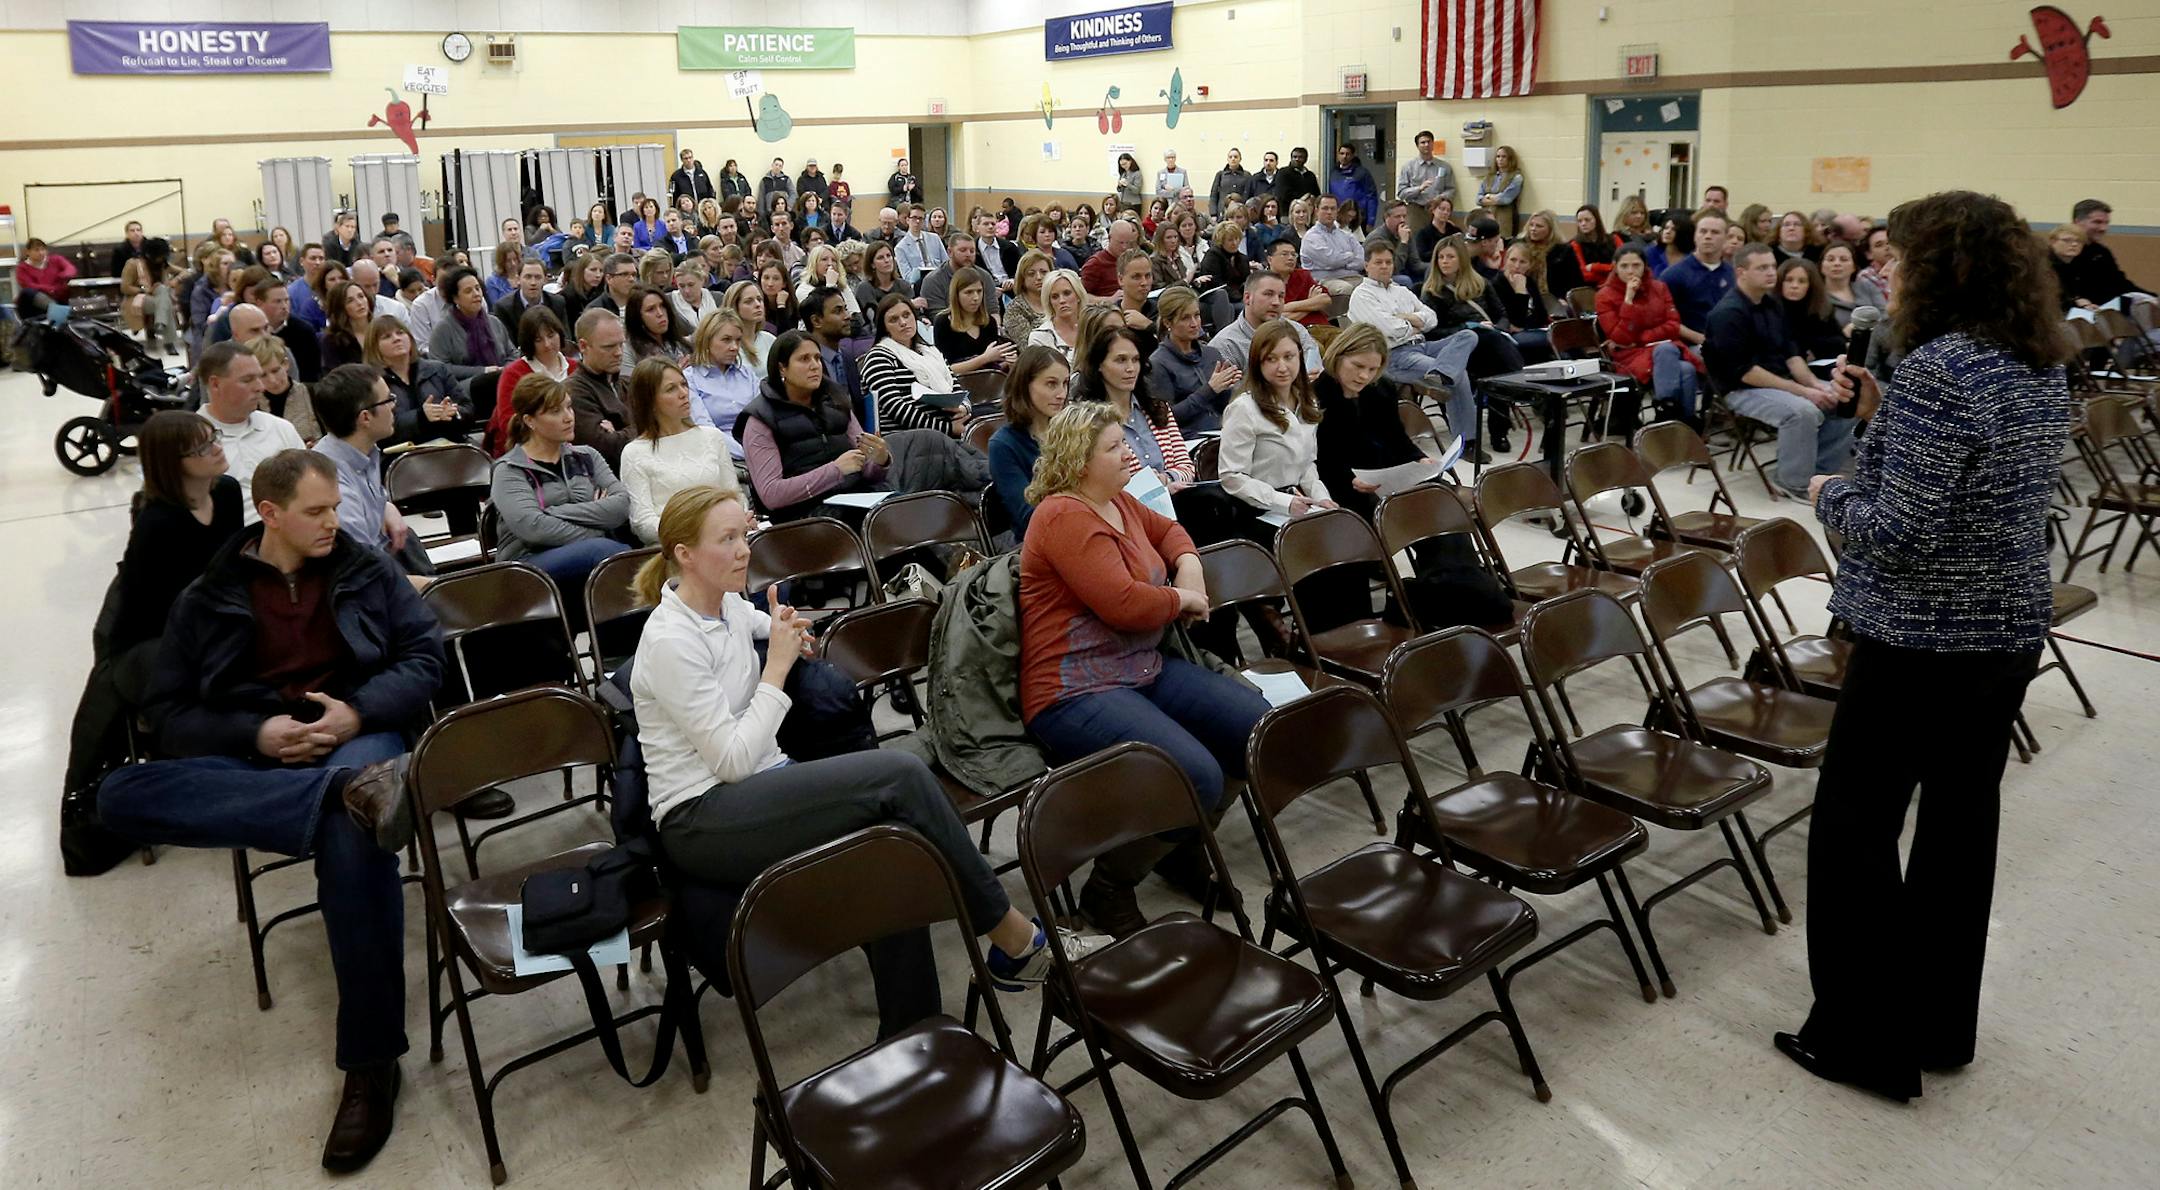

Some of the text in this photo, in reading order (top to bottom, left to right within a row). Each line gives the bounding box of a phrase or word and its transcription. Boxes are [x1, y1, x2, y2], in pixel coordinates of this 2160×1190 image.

[1070, 12, 1143, 40] KINDNESS
[137, 30, 270, 53] HONESTY
[723, 34, 815, 52] PATIENCE
[1054, 34, 1162, 54] Being Thoughtful and Thinking of Others
[121, 55, 287, 67] Refusal to Lie, Steal or Deceive
[738, 54, 802, 63] Calm Self Control
[1627, 55, 1650, 75] EXIT
[417, 66, 436, 76] EAT
[732, 70, 749, 80] EAT
[403, 81, 447, 93] VEGGIES
[734, 84, 759, 97] FRUIT
